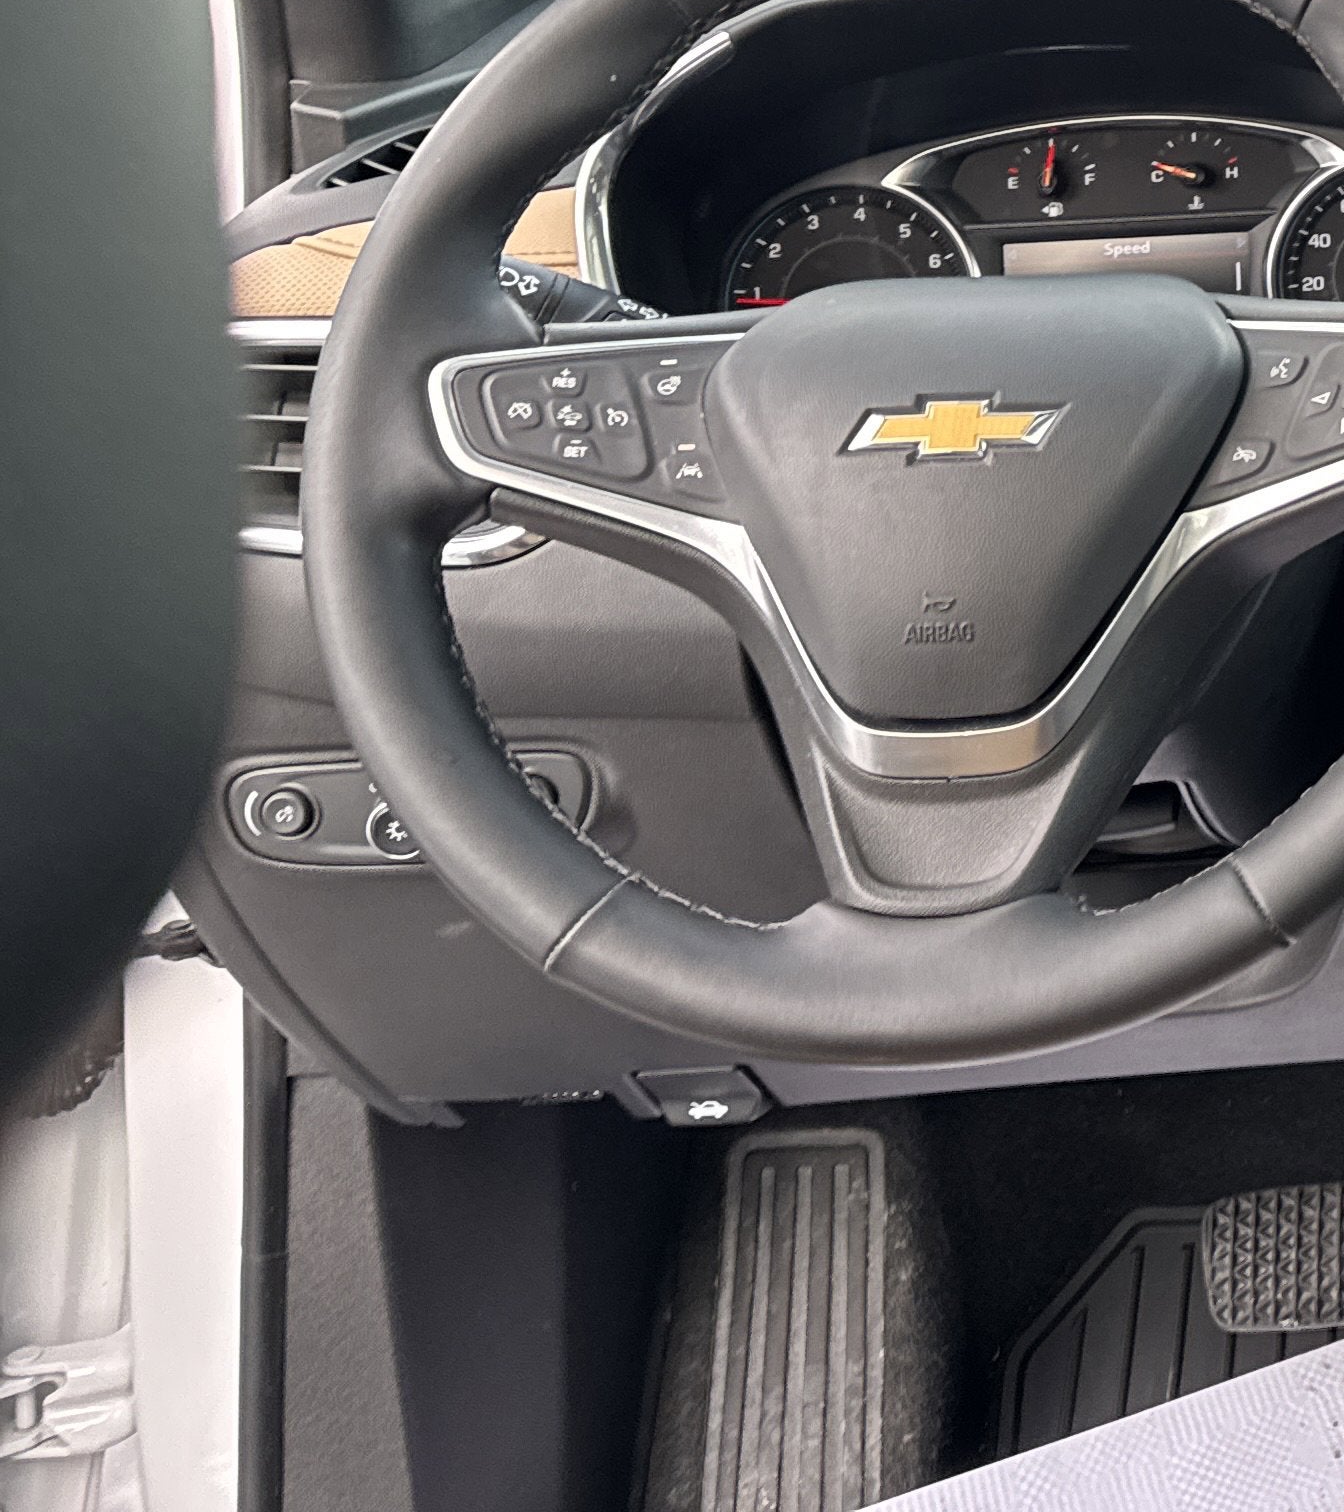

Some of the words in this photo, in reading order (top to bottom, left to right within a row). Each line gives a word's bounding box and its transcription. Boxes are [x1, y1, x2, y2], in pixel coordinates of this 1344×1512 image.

[1084, 172, 1096, 186] F
[1151, 170, 1164, 183] C
[1225, 166, 1239, 179] H
[1007, 176, 1019, 190] E
[807, 214, 820, 230] 3
[853, 206, 867, 222] 4
[898, 223, 912, 239] 5
[1308, 233, 1332, 249] 40
[768, 242, 782, 259] 2
[1103, 240, 1151, 259] Speed
[928, 253, 942, 269] 6
[1301, 275, 1325, 292] 20
[753, 286, 761, 301] 1
[552, 376, 577, 389] RES
[563, 445, 589, 458] SET
[904, 621, 975, 645] AIRBAG
